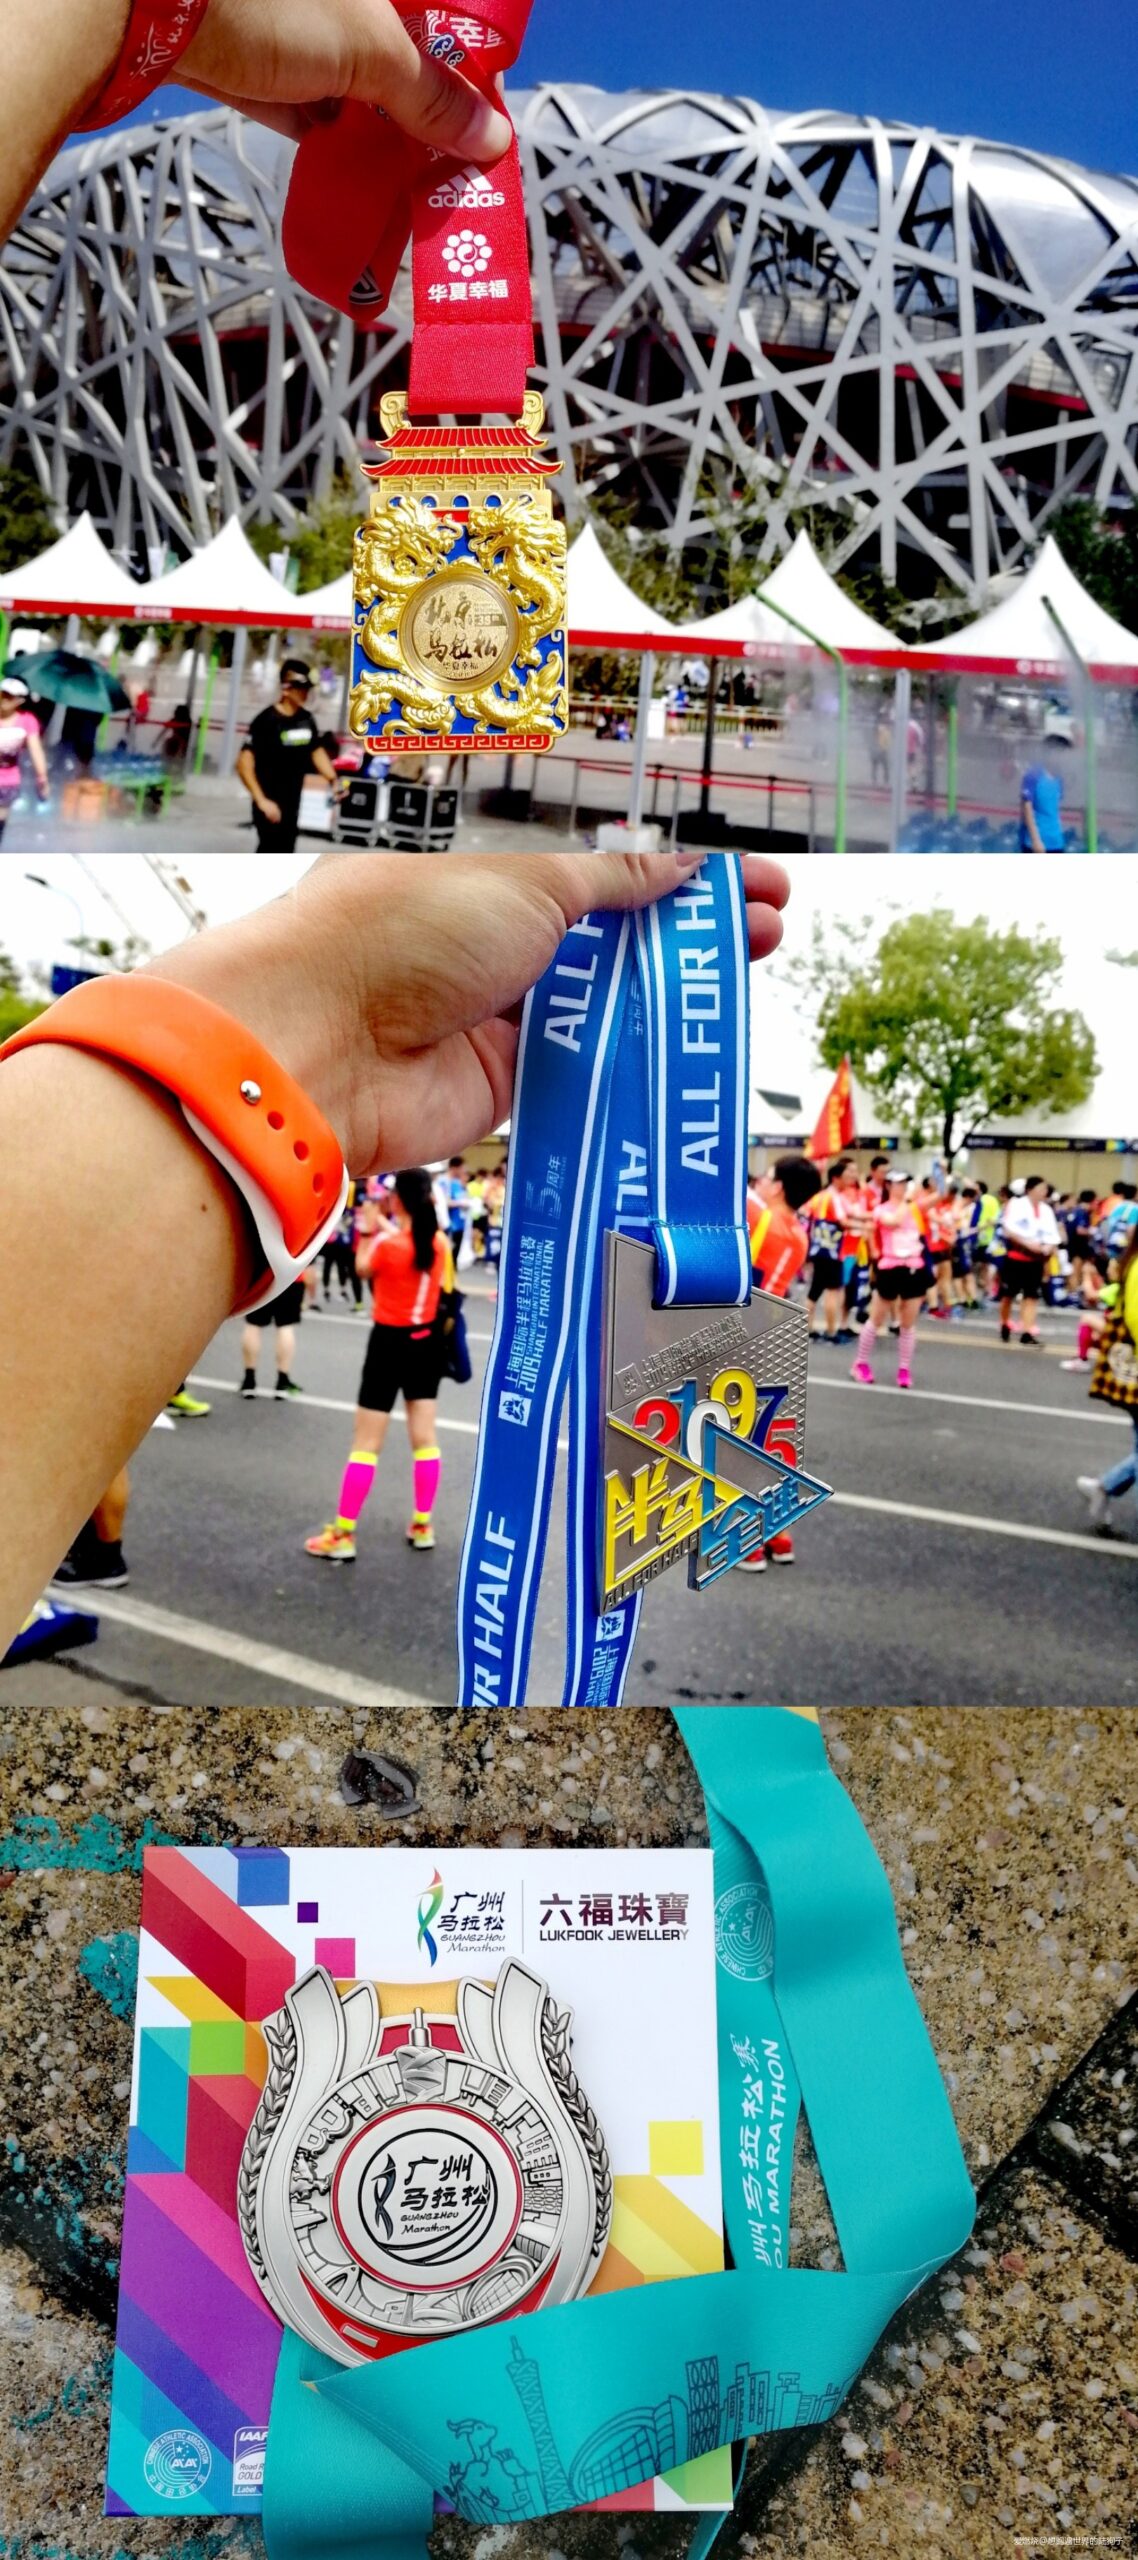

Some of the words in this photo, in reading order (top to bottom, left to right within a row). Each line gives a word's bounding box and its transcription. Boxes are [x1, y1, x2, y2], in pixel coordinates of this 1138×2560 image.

[428, 189, 506, 208] adidas
[428, 280, 509, 304] 华夏幸福
[423, 629, 498, 663] 马拉松
[544, 953, 598, 1053] ALL
[679, 945, 720, 1054] FOR
[681, 1070, 720, 1177] ALL
[538, 1239, 556, 1318] MARATHON
[504, 1235, 537, 1389] 上海国际半程马拉松赛
[532, 1320, 549, 1359] HALF
[517, 1356, 541, 1394] 2019
[474, 1511, 517, 1660] HALF
[450, 1891, 506, 1913] 广州
[539, 1892, 690, 1927] 六福珠寶
[437, 1914, 505, 1932] 马拉松
[539, 1929, 604, 1941] LUKFOOK
[607, 1929, 689, 1941] JEWELLERY
[440, 1934, 506, 1943] GUANGZHOU
[446, 1942, 506, 1953] Marathon
[761, 2038, 787, 2215] MARATHON
[404, 2153, 474, 2186] 广州
[400, 2185, 489, 2211] 马拉松
[400, 2210, 459, 2222] GUANGZHOU
[401, 2222, 451, 2235] Marathon
[237, 2471, 262, 2481] GOLD
[240, 2463, 258, 2471] Road
